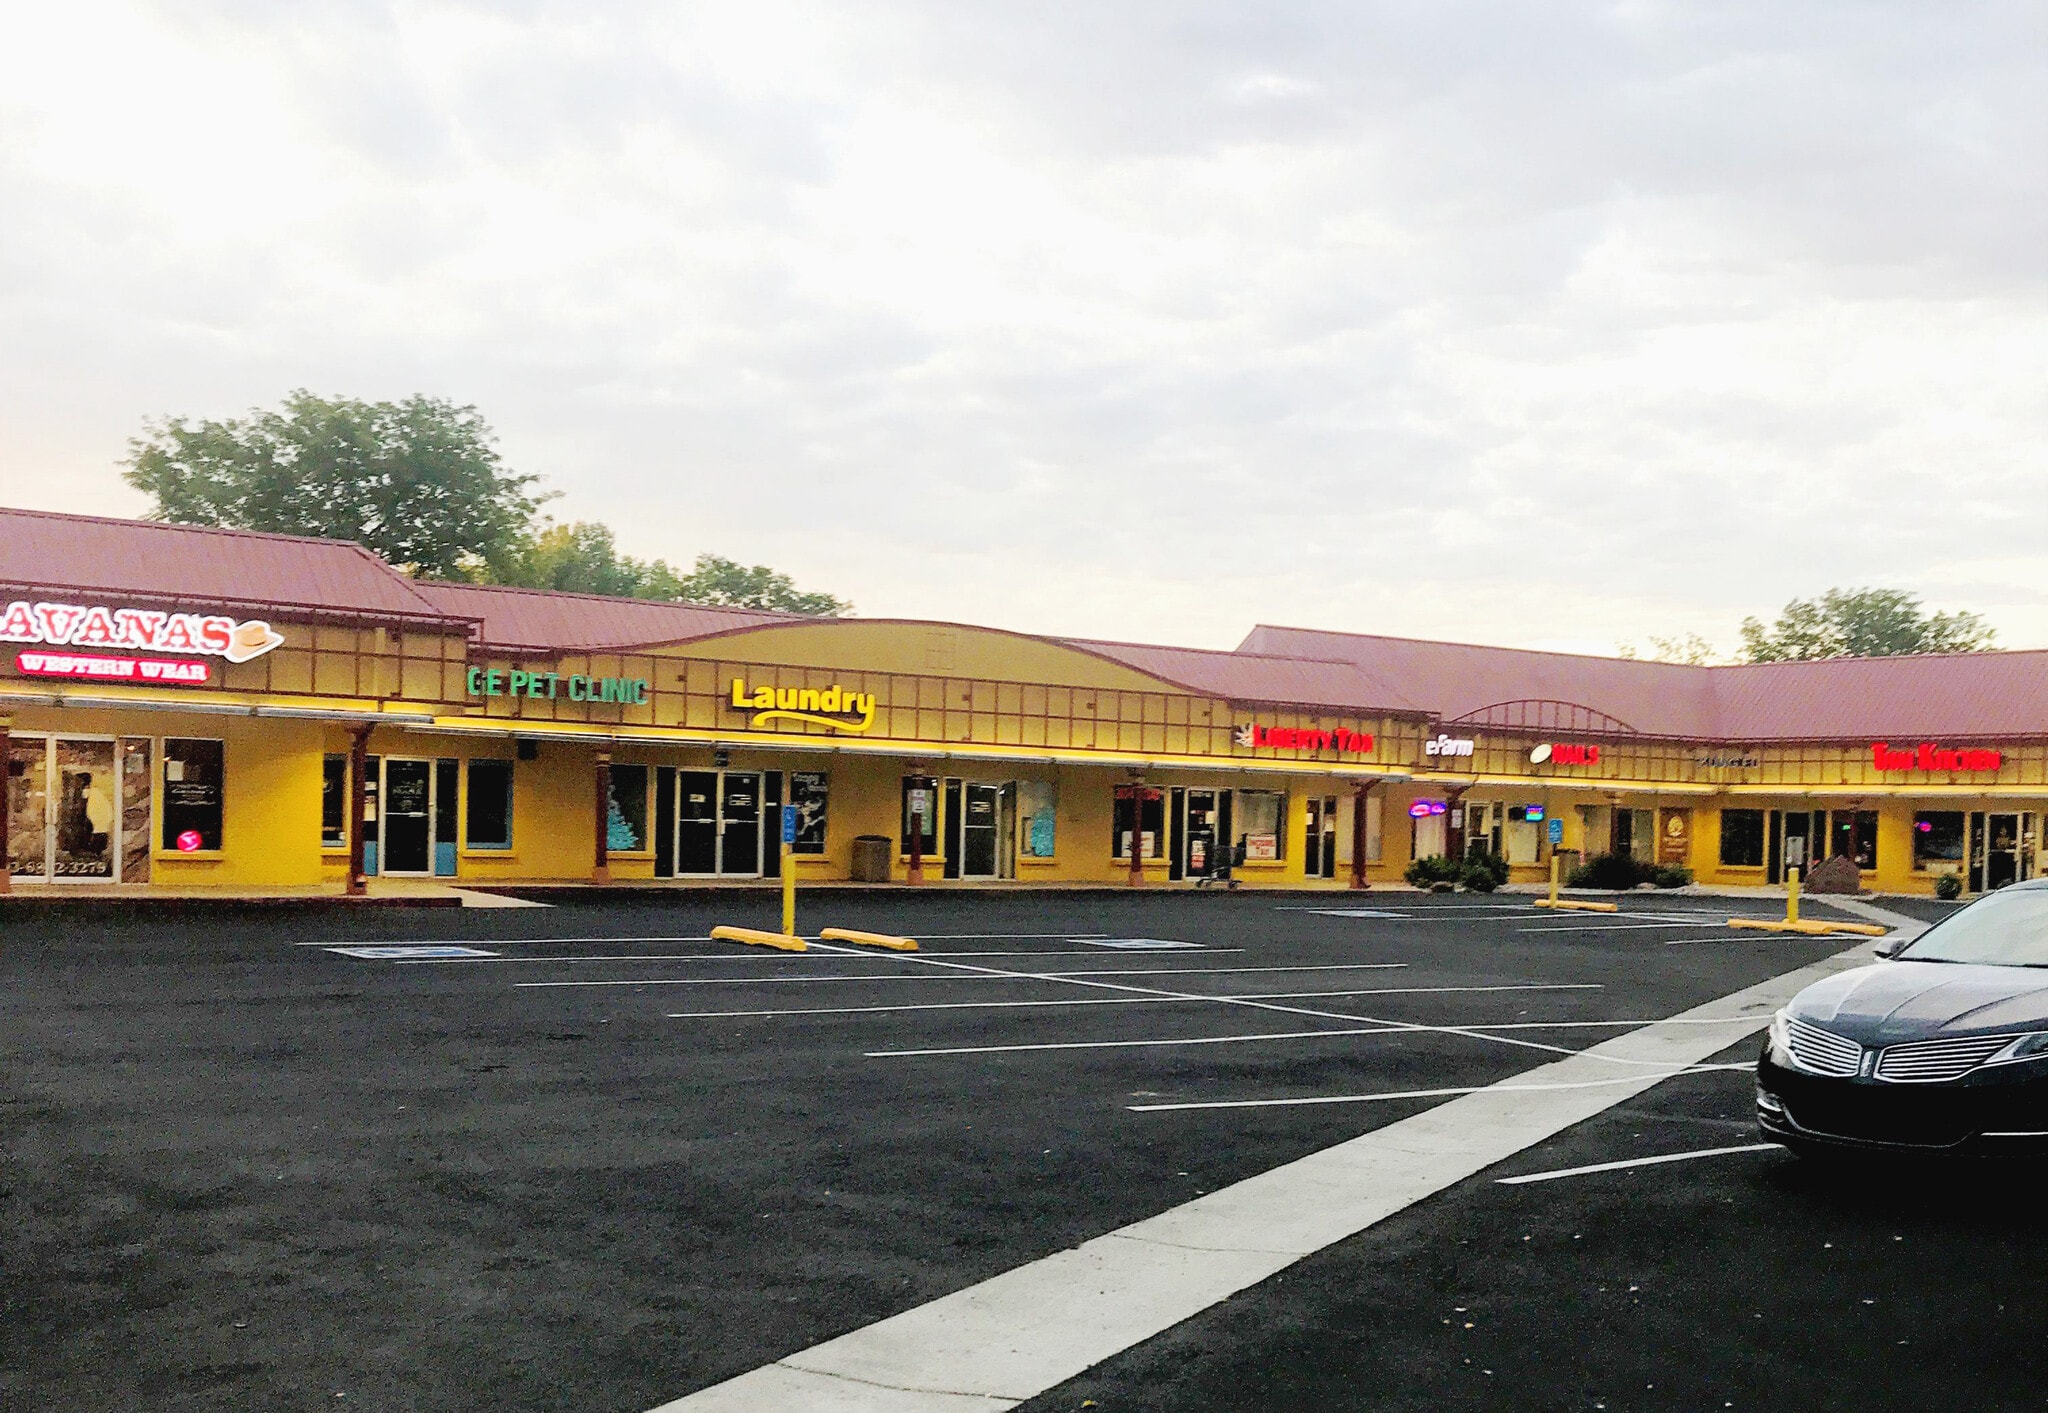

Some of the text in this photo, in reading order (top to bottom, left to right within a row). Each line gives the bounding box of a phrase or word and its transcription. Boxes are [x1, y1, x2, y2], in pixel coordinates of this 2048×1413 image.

[20, 654, 208, 681] WESTERN WEAR
[510, 669, 560, 699] PET
[568, 674, 649, 704] CLINIC
[732, 678, 876, 731] Laundry
[1253, 724, 1374, 752] LIBERTY TAX
[1551, 743, 1599, 766] NAILS
[1918, 743, 2001, 771] KITCHEN
